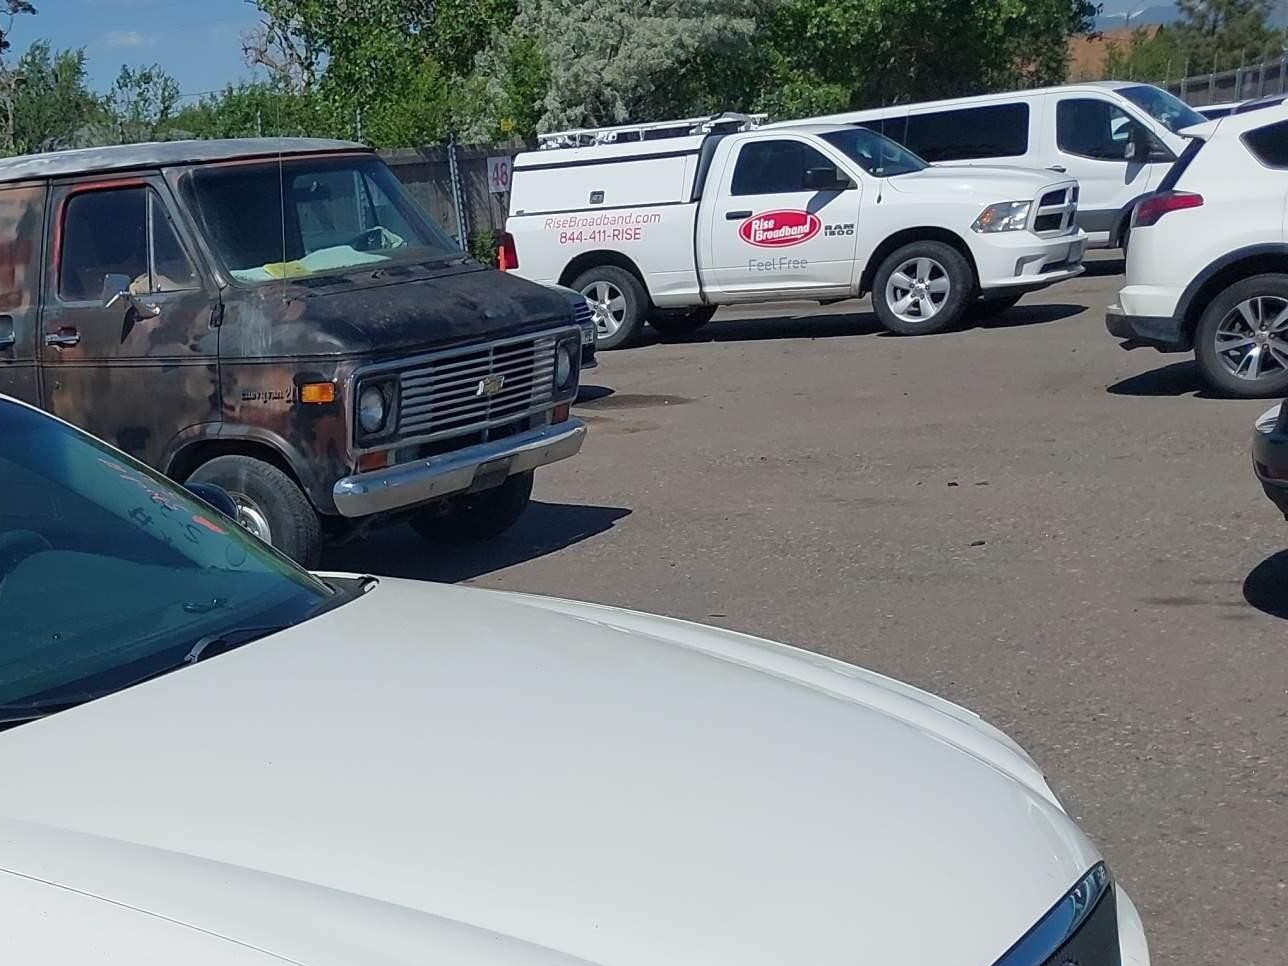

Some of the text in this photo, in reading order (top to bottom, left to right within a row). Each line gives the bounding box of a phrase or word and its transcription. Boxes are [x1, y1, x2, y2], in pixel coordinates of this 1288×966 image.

[493, 162, 509, 186] 48
[544, 213, 661, 230] RiseBroadband.com
[751, 218, 775, 233] Rise
[755, 216, 811, 241] Broadband
[824, 223, 855, 231] RAM
[559, 228, 642, 244] 844-411-RISE
[824, 229, 854, 237] 1500
[748, 256, 808, 272] Feel Free
